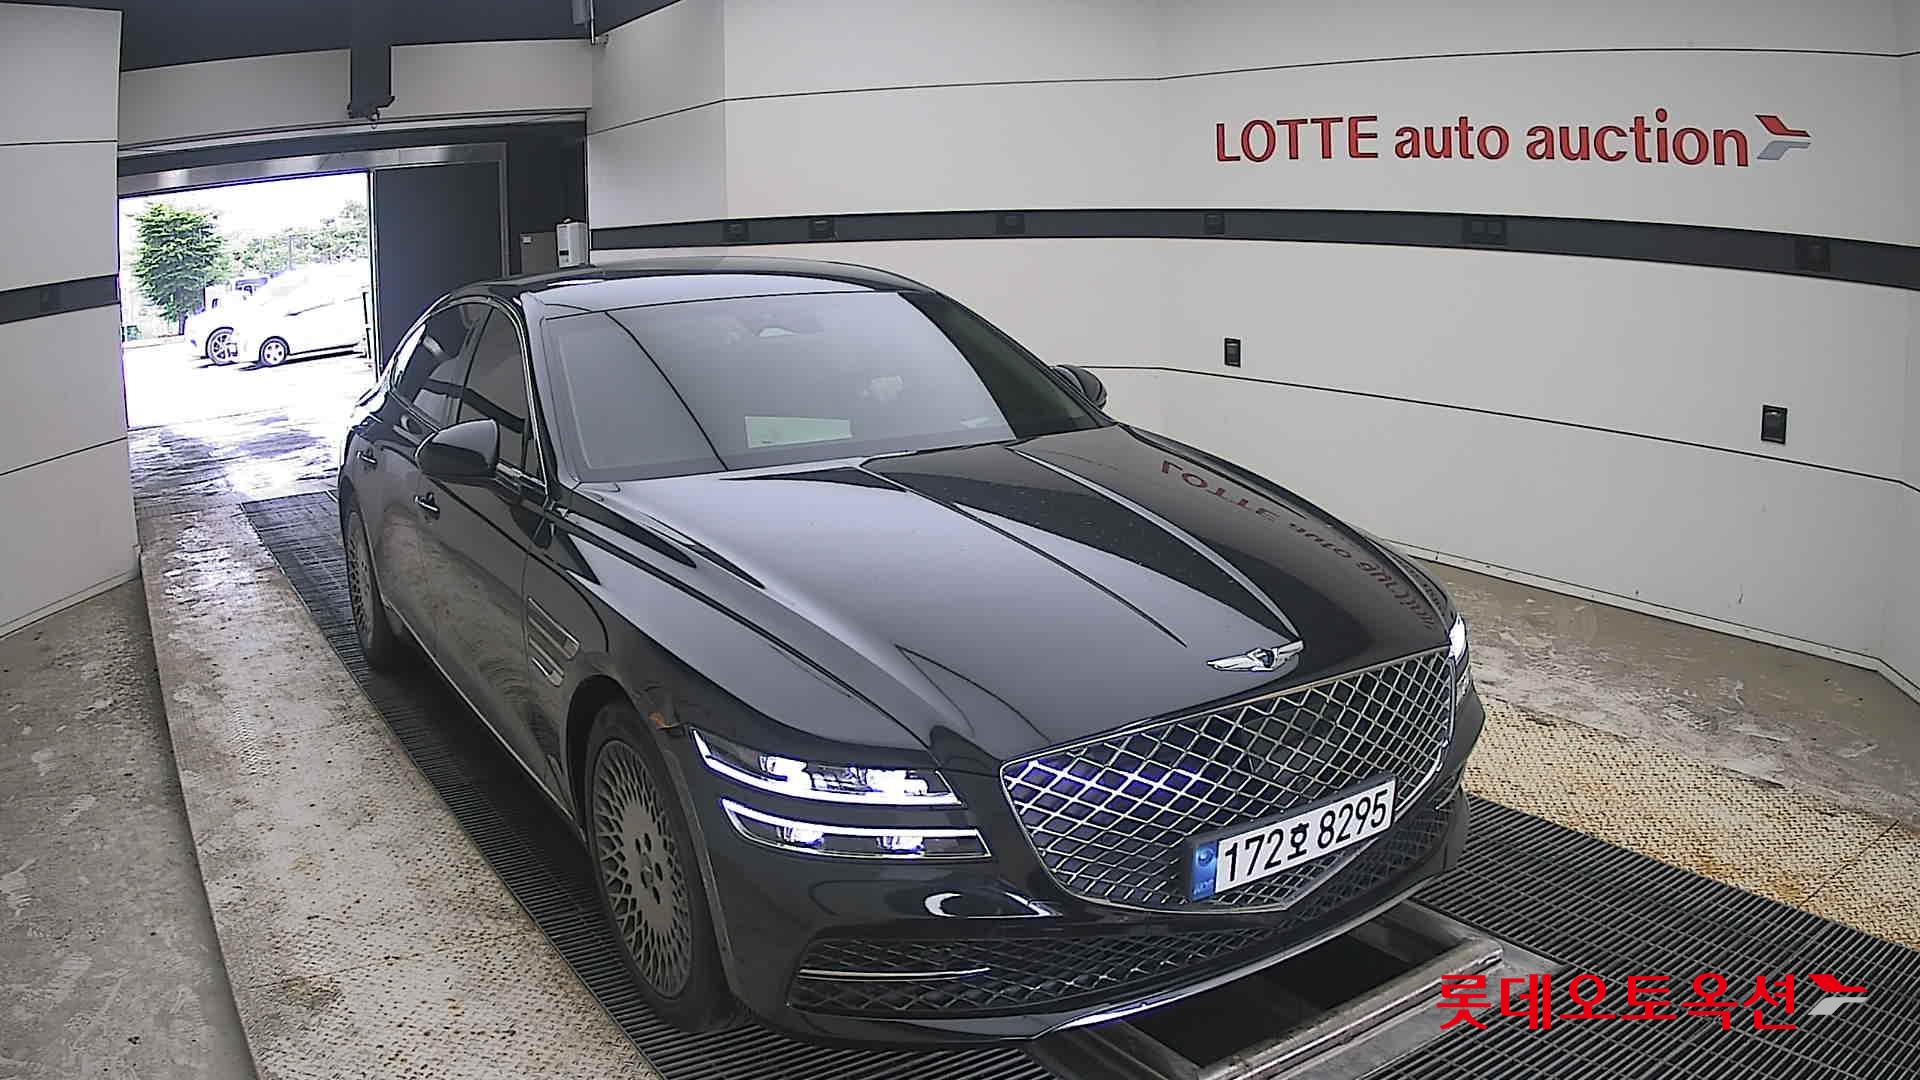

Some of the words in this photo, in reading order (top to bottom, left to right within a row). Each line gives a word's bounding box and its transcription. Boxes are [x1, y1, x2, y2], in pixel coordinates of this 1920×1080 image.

[1215, 115, 1378, 162] LOTTE
[1394, 115, 1510, 162] auto
[1525, 107, 1749, 167] auction
[1224, 822, 1311, 882] 172호
[1317, 789, 1389, 849] 8295
